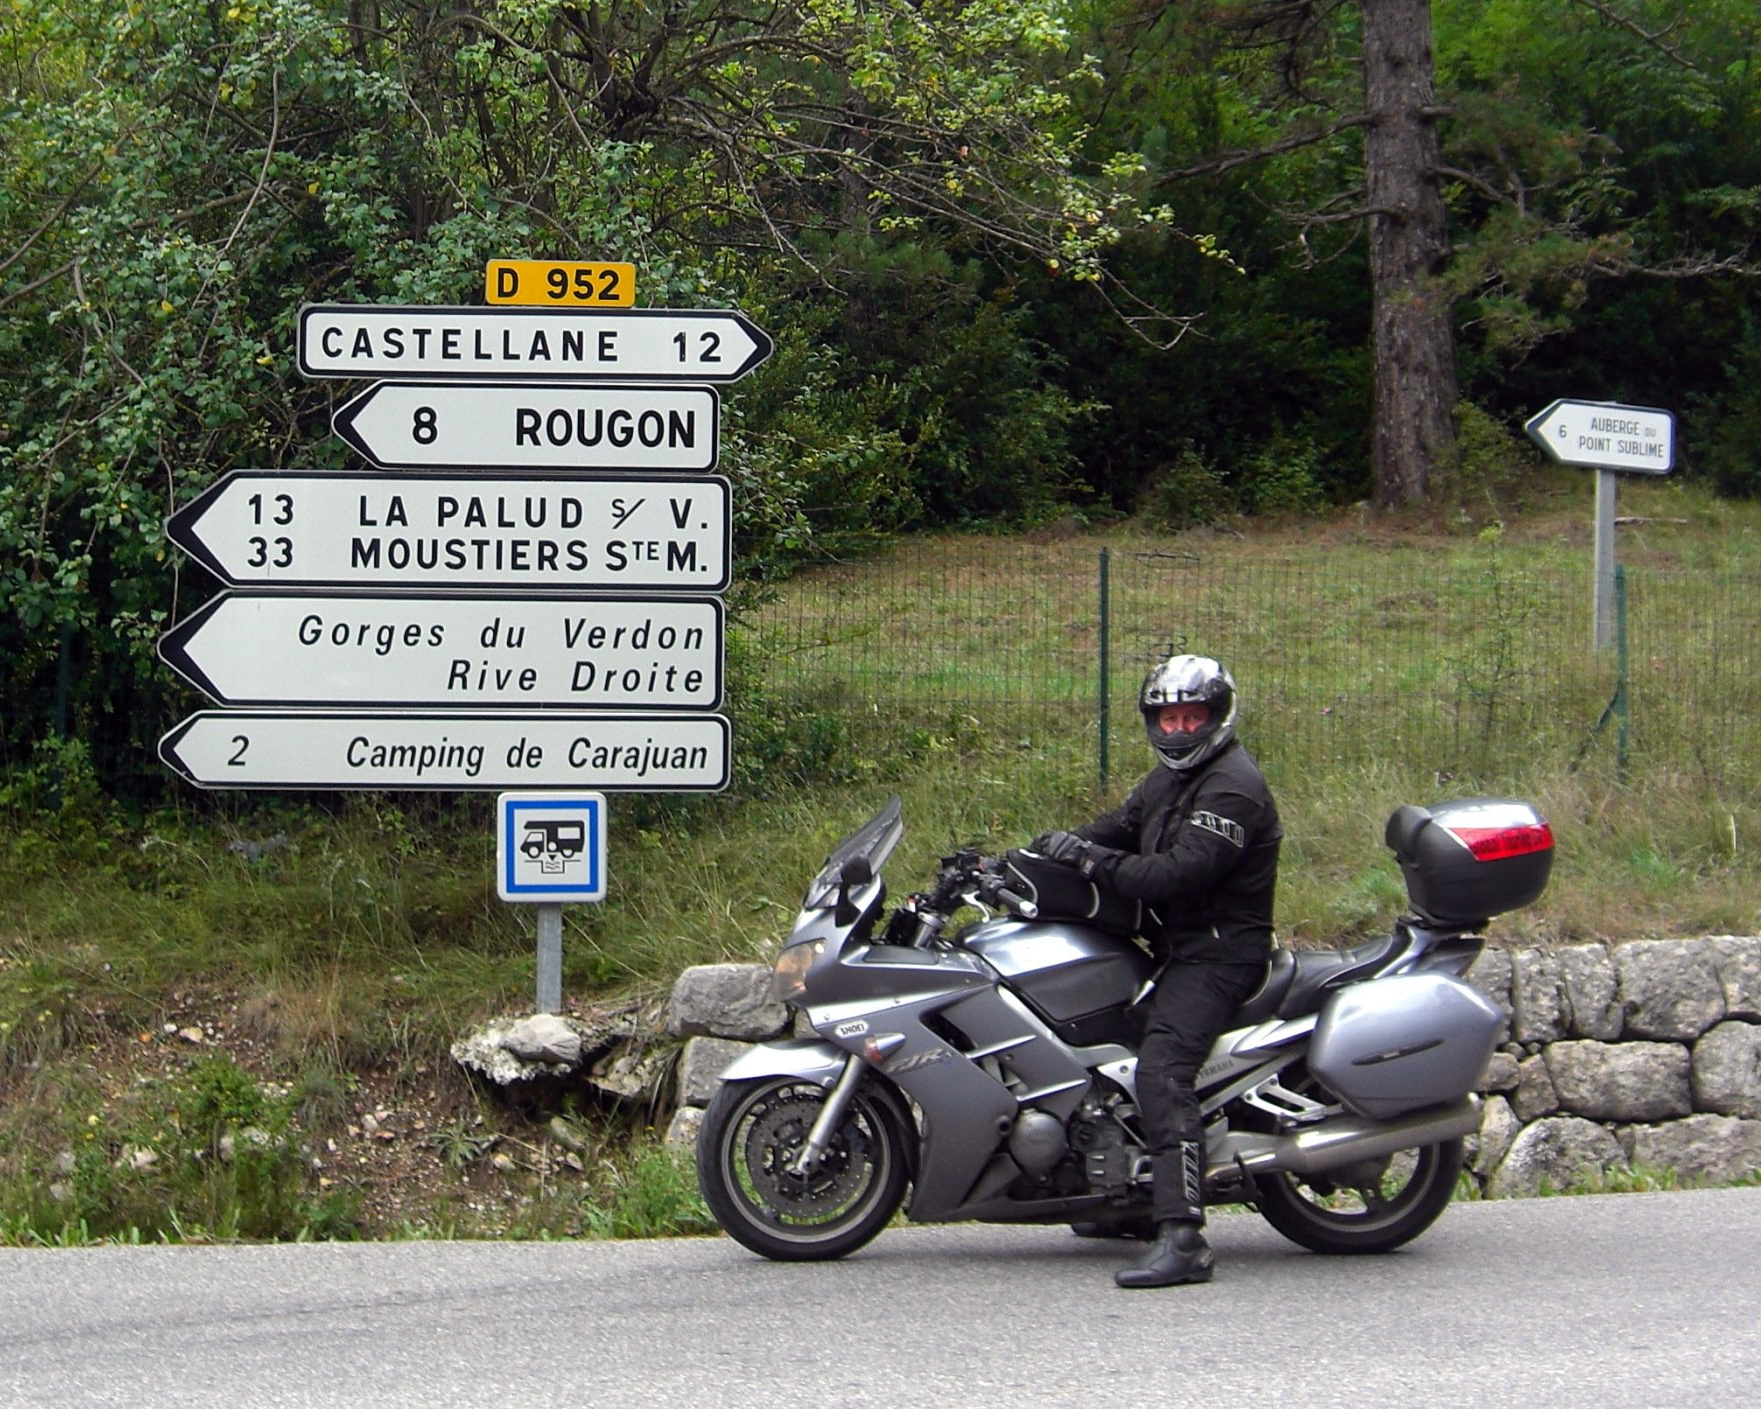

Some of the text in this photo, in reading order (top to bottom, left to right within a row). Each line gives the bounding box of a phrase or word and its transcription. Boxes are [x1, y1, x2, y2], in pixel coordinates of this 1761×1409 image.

[498, 268, 620, 300] D 952
[323, 327, 722, 363] CASTELLANE 12
[413, 407, 695, 448] 8 ROUGON
[1559, 424, 1567, 438] 6
[1591, 417, 1640, 436] AUBERGE
[1579, 435, 1664, 458] POINT SUBLIME
[248, 494, 294, 525] 13
[360, 496, 408, 527] LA
[438, 497, 583, 528] PALUD
[670, 499, 708, 529] V.
[248, 537, 293, 568] 33
[352, 538, 588, 571] MOUSTIERS
[299, 615, 703, 656] Gorges du Verdon
[448, 660, 703, 693] Rive Droite
[228, 736, 707, 777] 2 Camping de Carajuan
